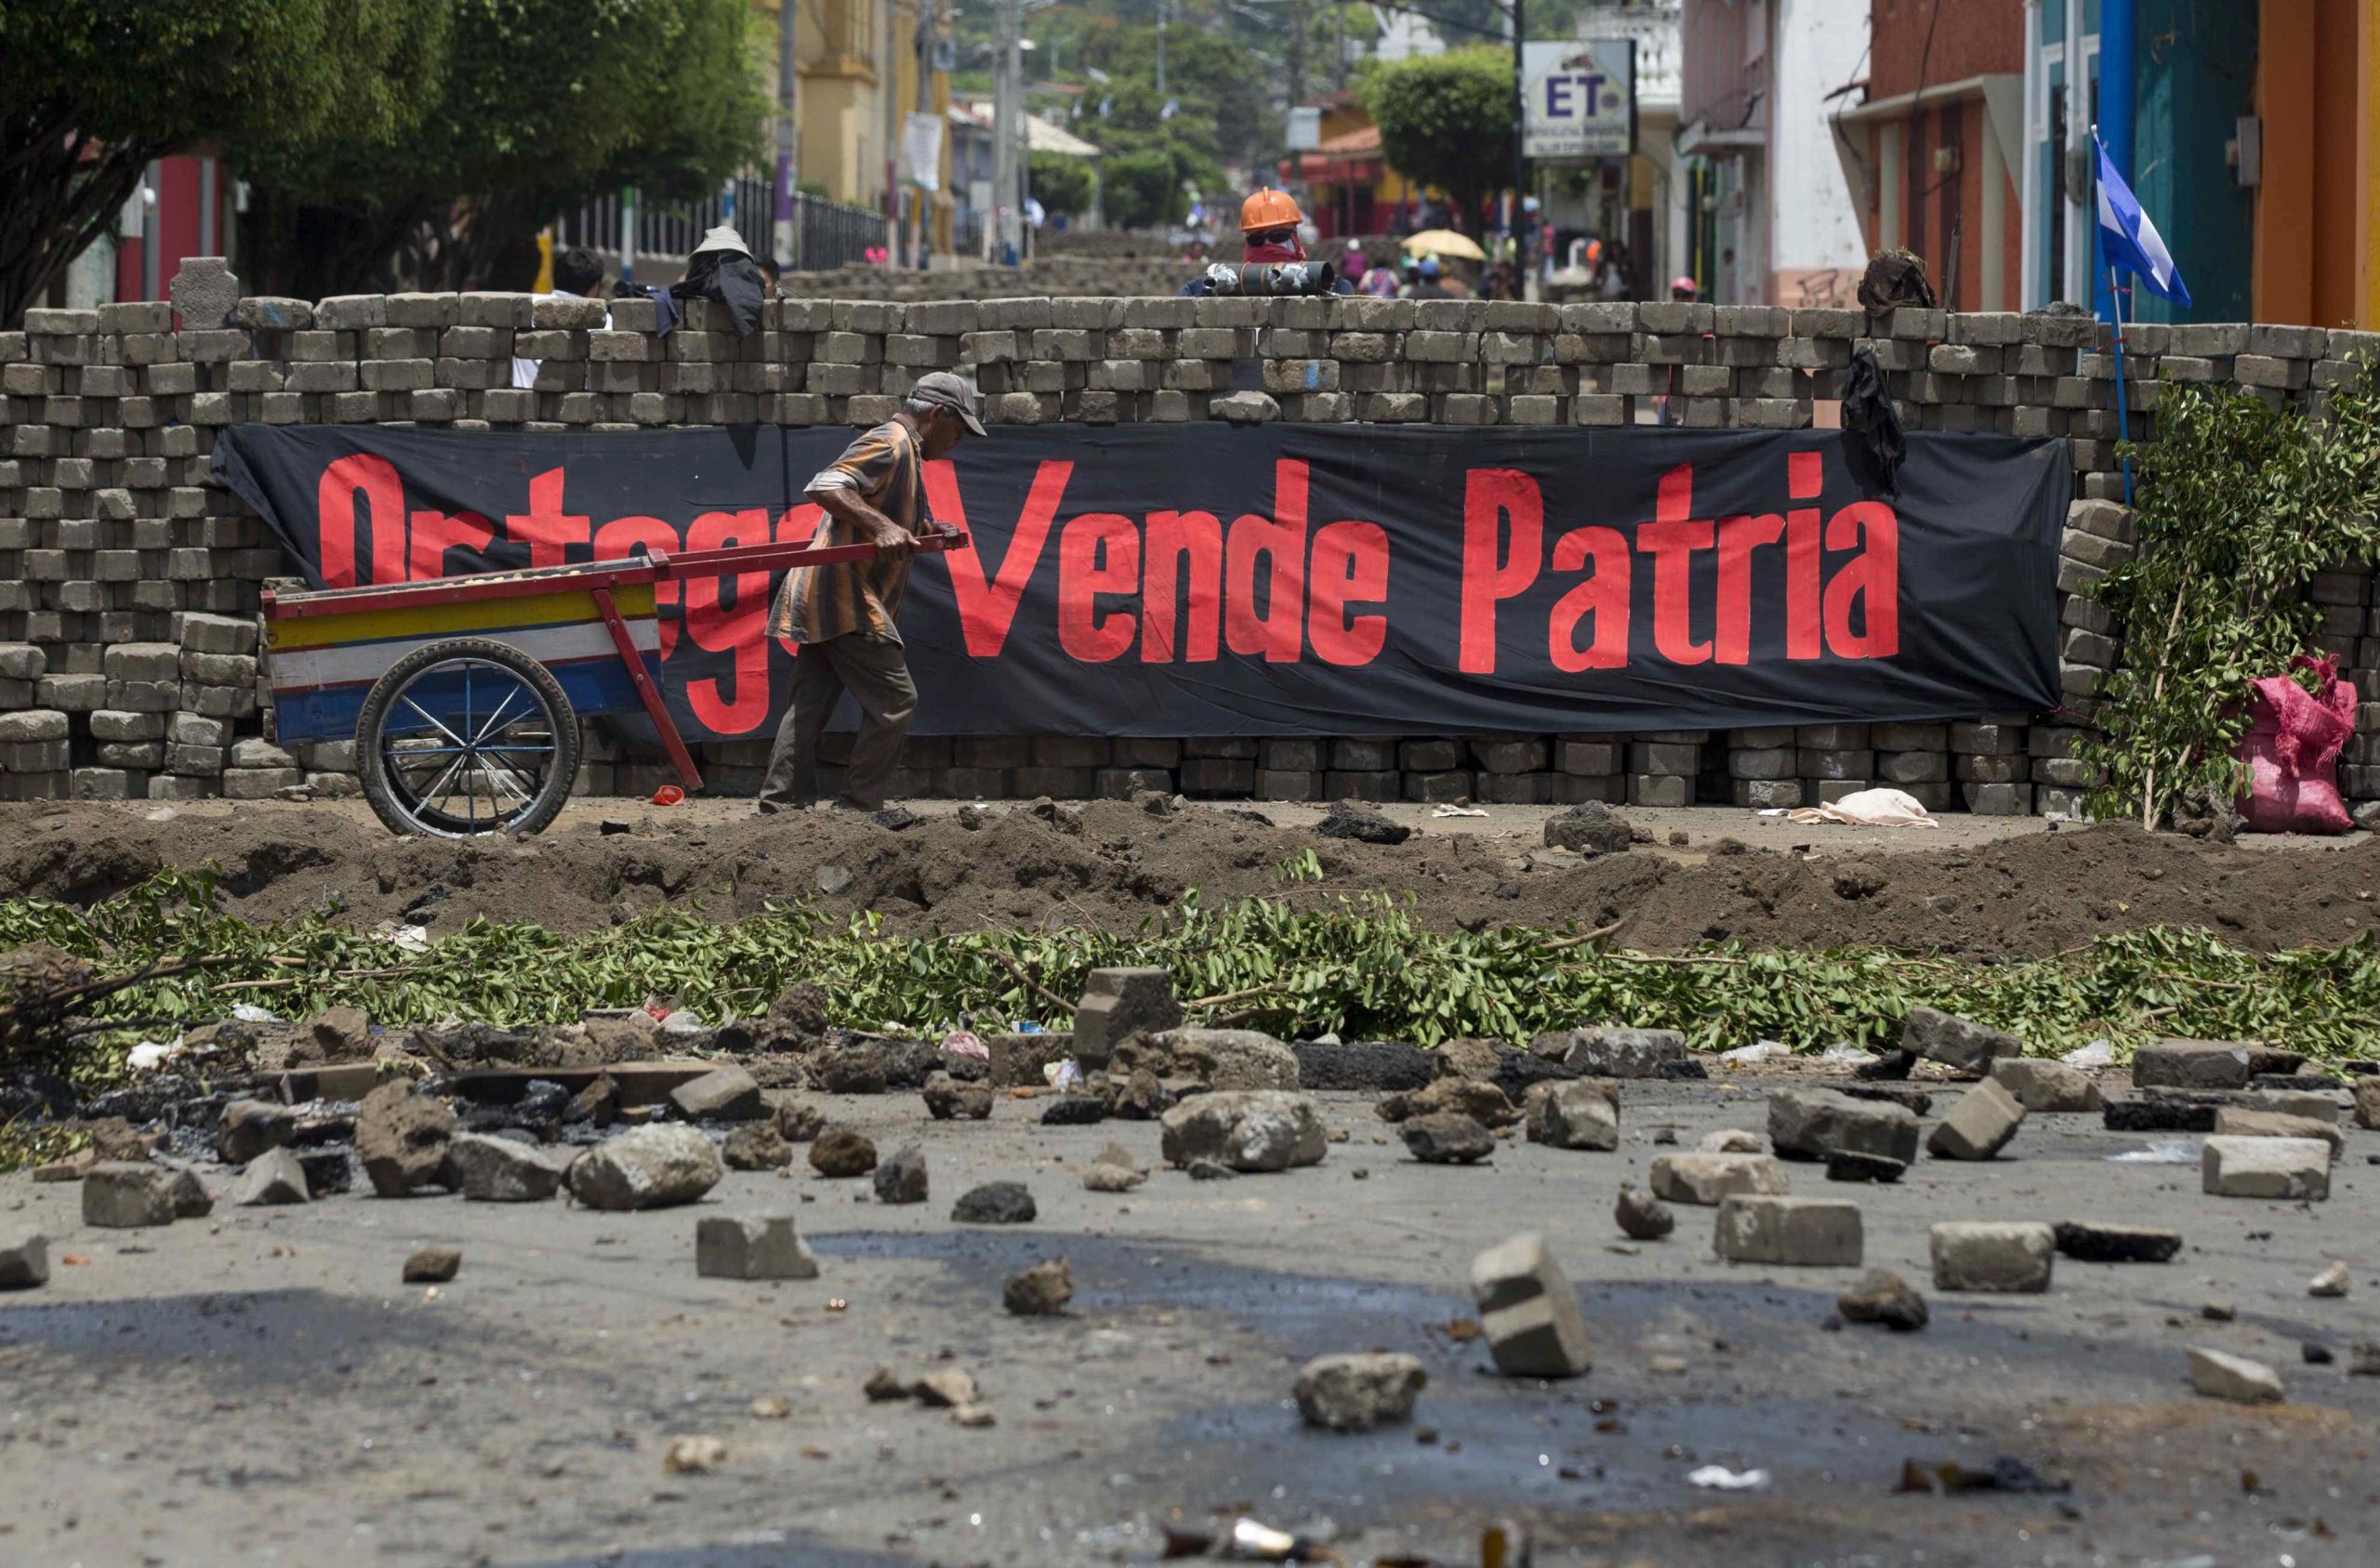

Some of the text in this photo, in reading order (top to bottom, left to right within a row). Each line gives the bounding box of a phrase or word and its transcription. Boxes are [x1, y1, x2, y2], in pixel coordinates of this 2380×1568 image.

[1546, 76, 1606, 117] ET
[318, 452, 1898, 734] Orteg Vende Patria
